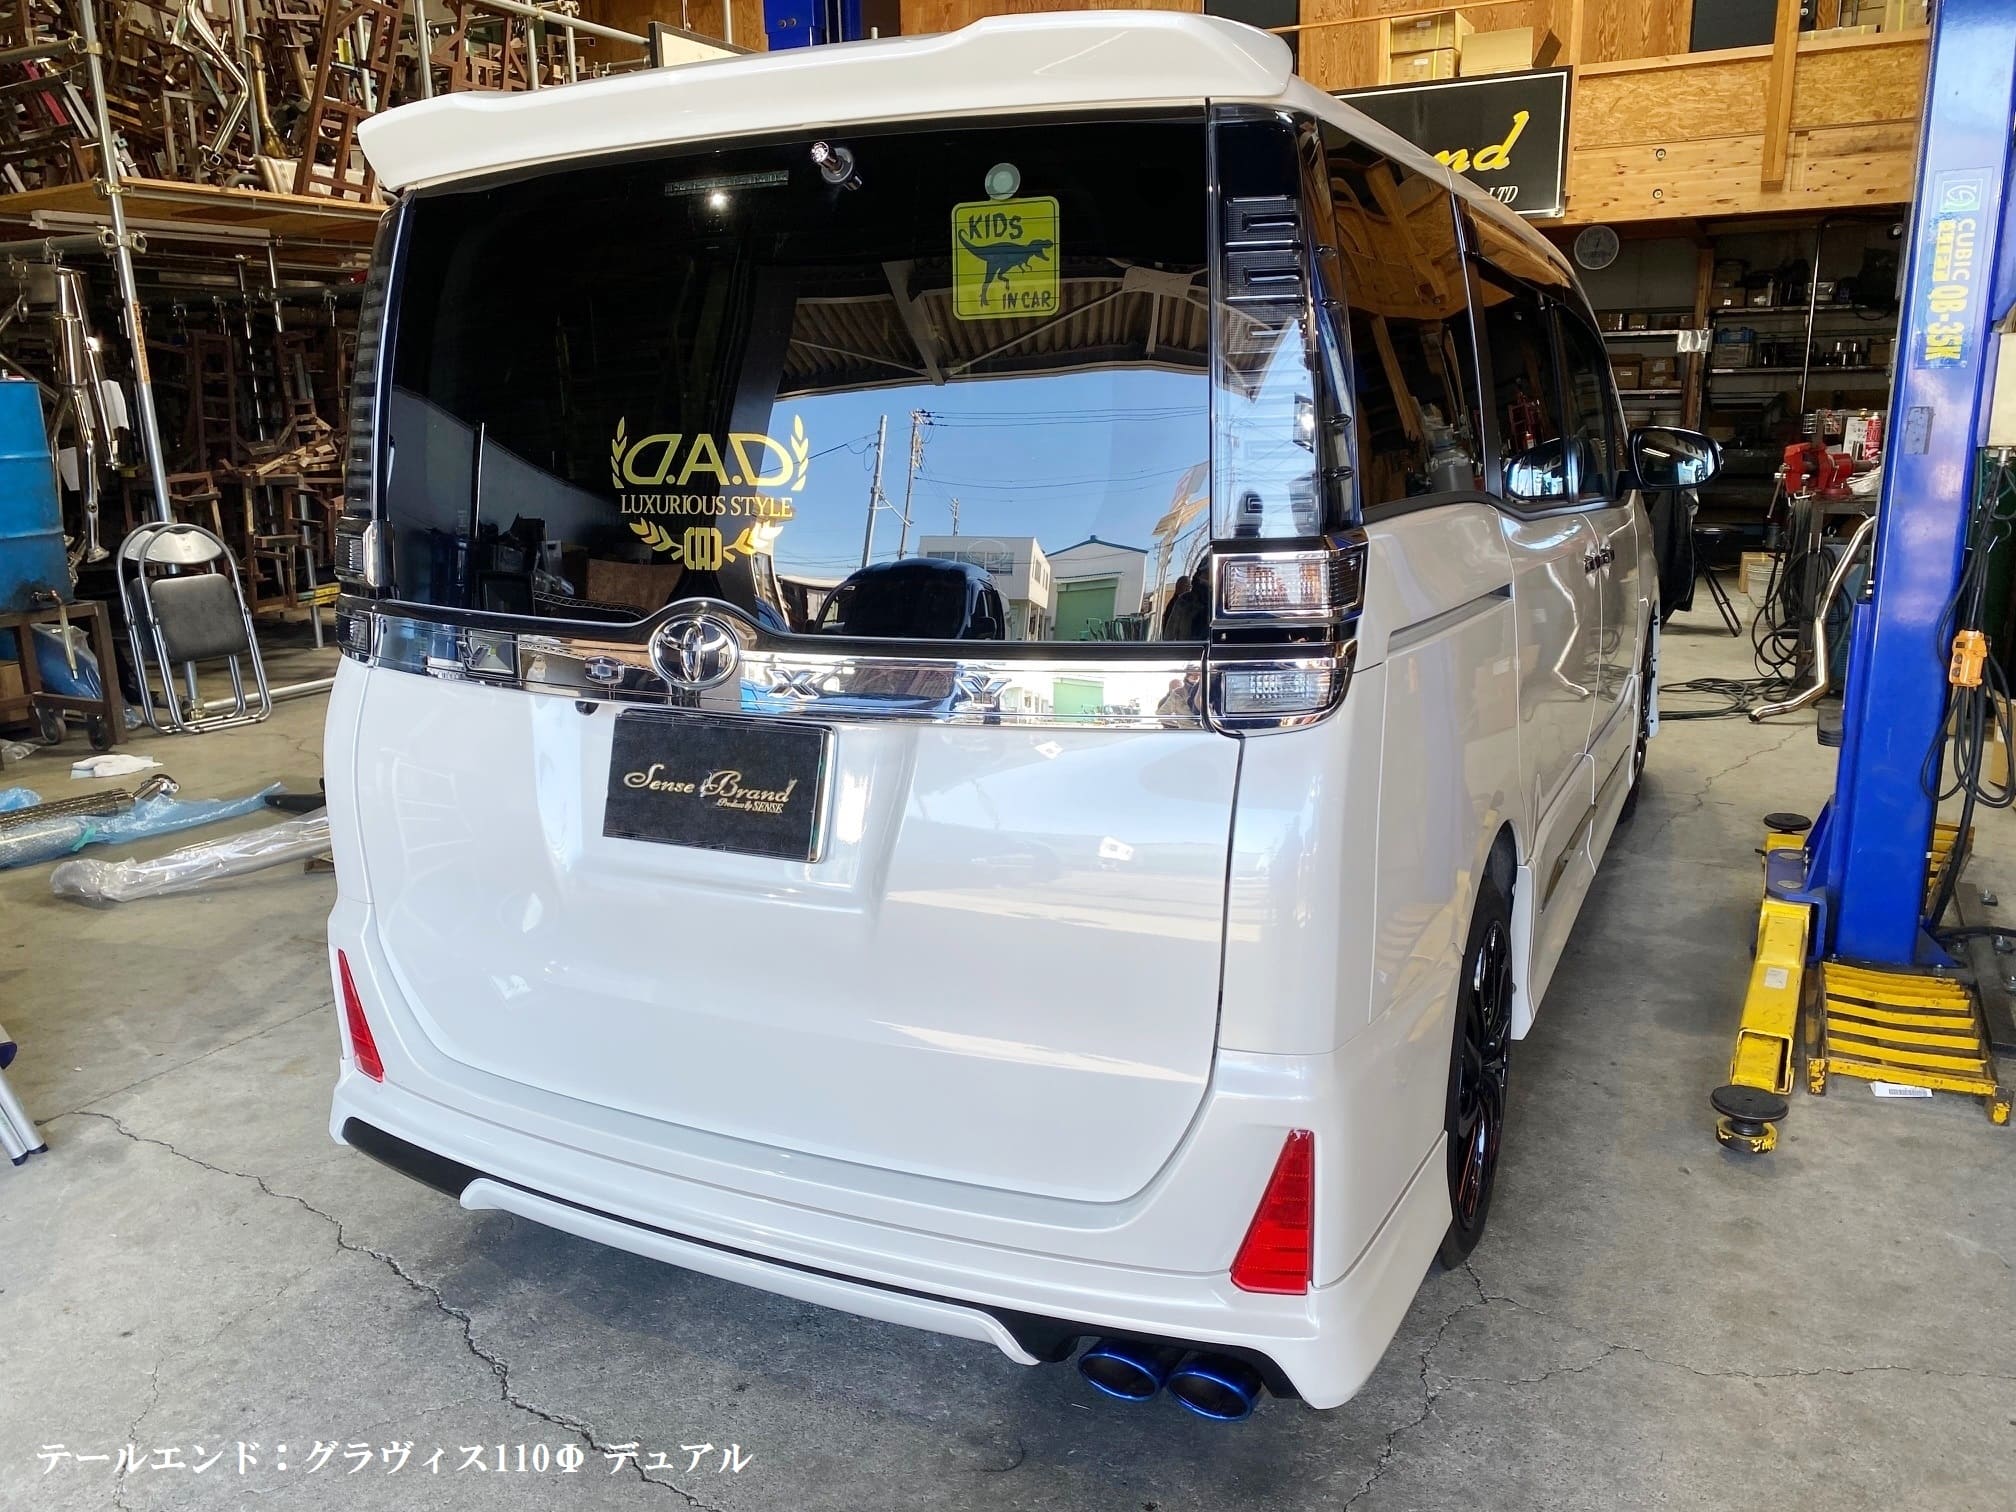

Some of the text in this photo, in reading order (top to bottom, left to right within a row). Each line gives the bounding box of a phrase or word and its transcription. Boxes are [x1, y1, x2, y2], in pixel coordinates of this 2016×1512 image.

[968, 212, 1023, 240] KIDS
[1952, 218, 1976, 281] CUBIC
[1002, 290, 1051, 310] IN CAR
[620, 494, 793, 518] LUXURIOUS STYLE
[623, 763, 798, 803] Sense Brand
[752, 801, 785, 814] SENSE
